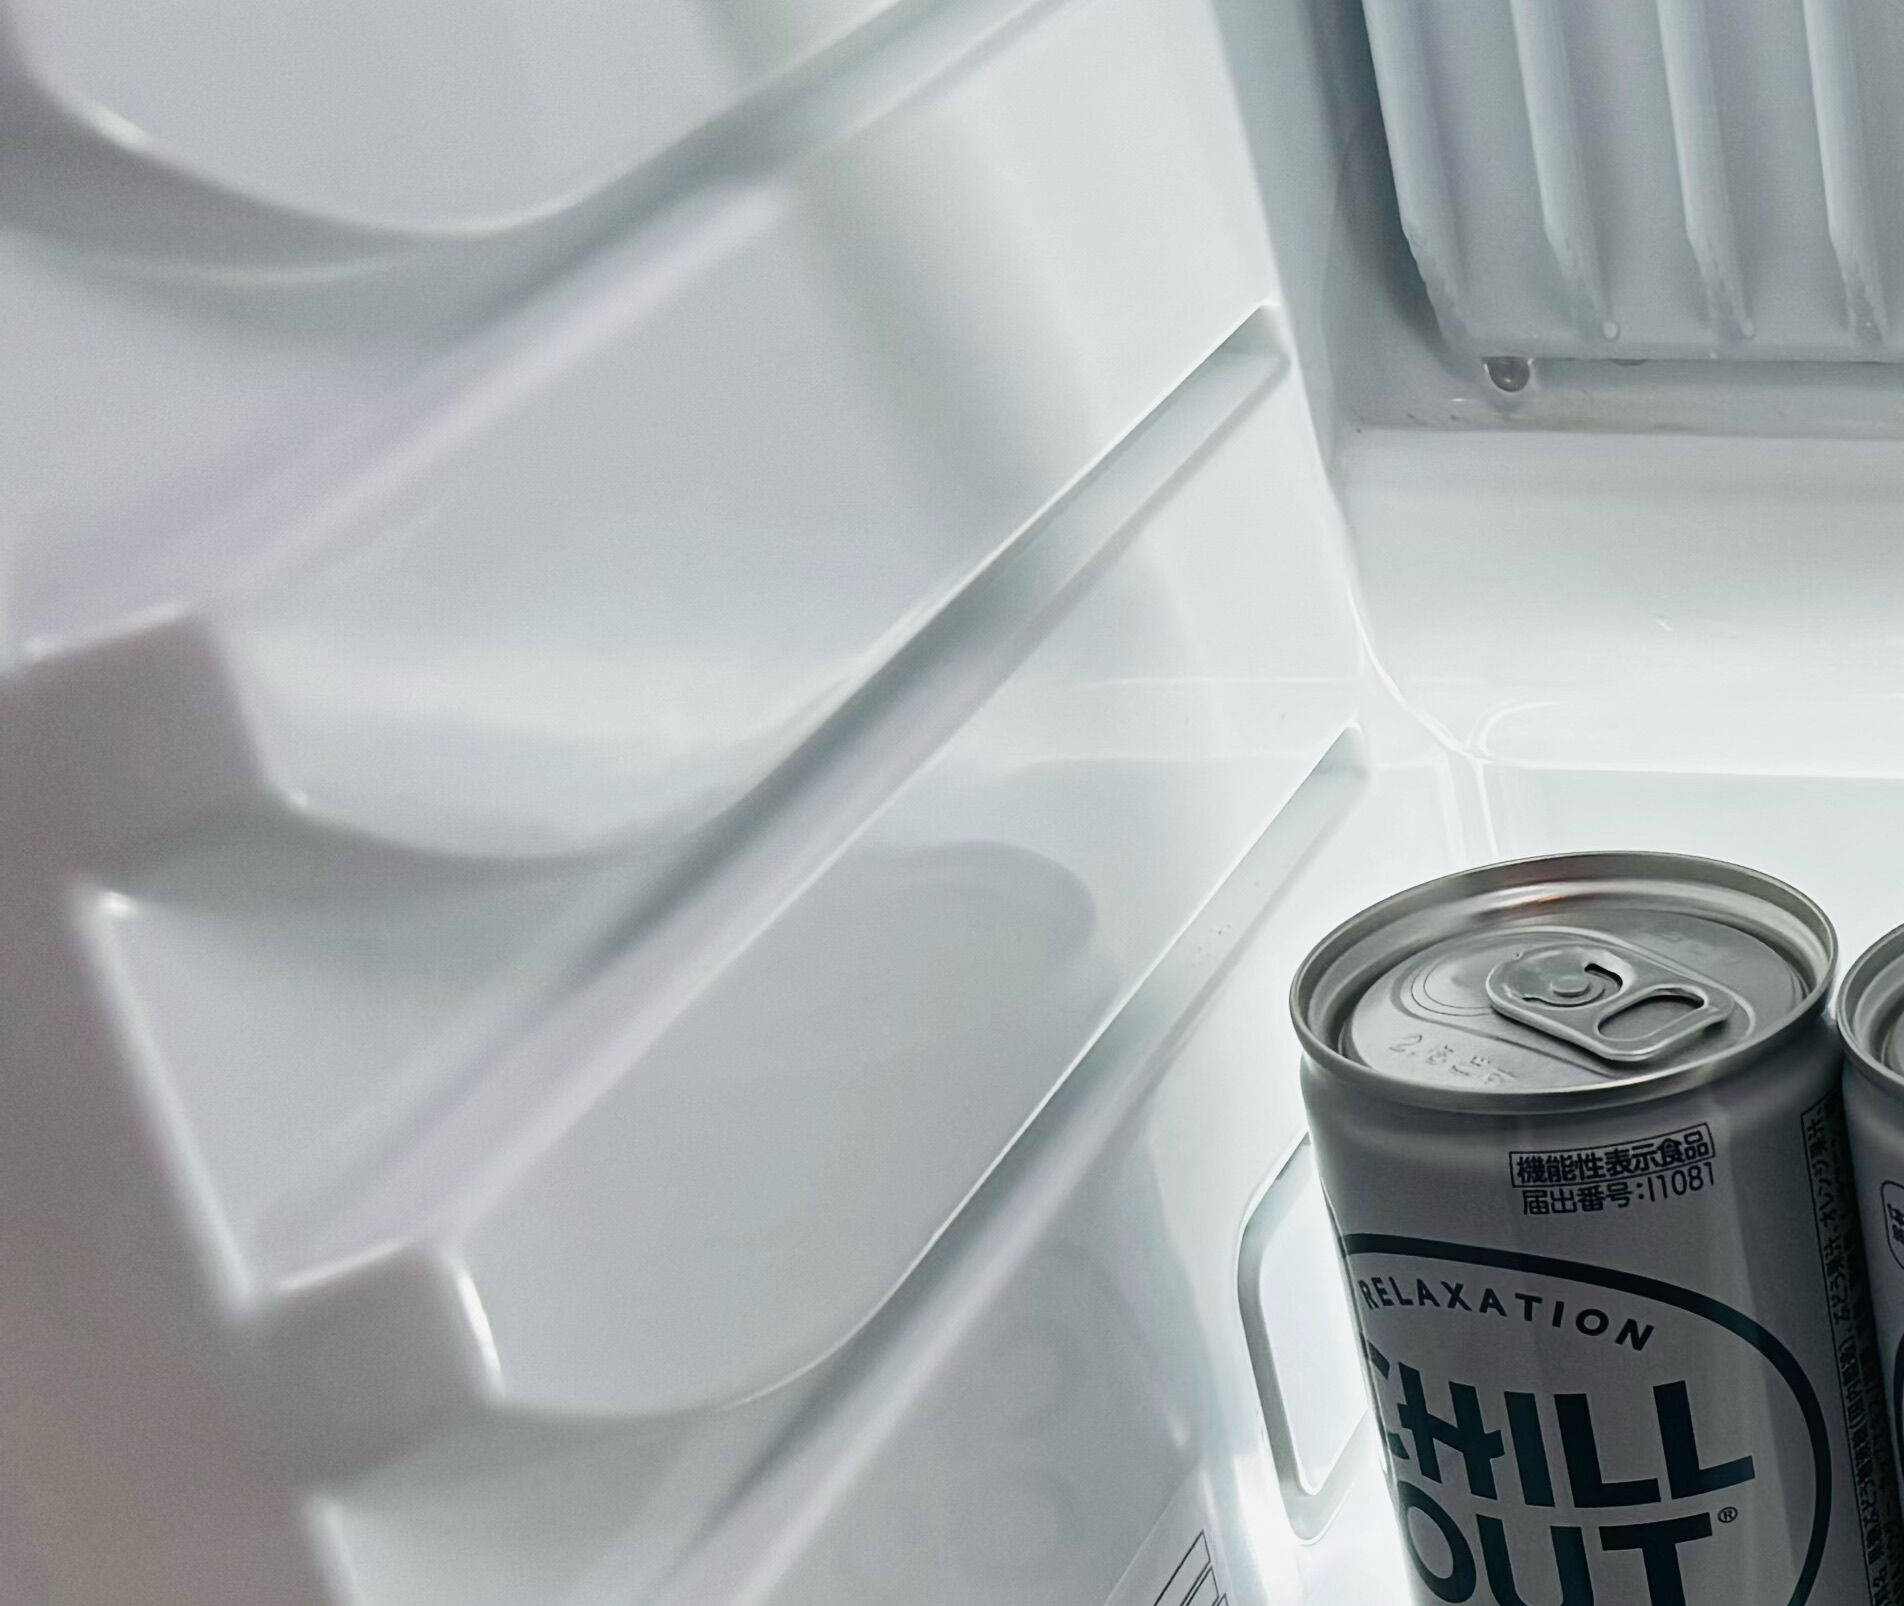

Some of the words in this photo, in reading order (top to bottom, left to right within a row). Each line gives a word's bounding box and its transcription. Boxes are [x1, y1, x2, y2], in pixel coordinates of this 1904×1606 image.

[1515, 1126, 1711, 1185] 機能性表示食品
[1360, 1275, 1655, 1353] RELAXATION
